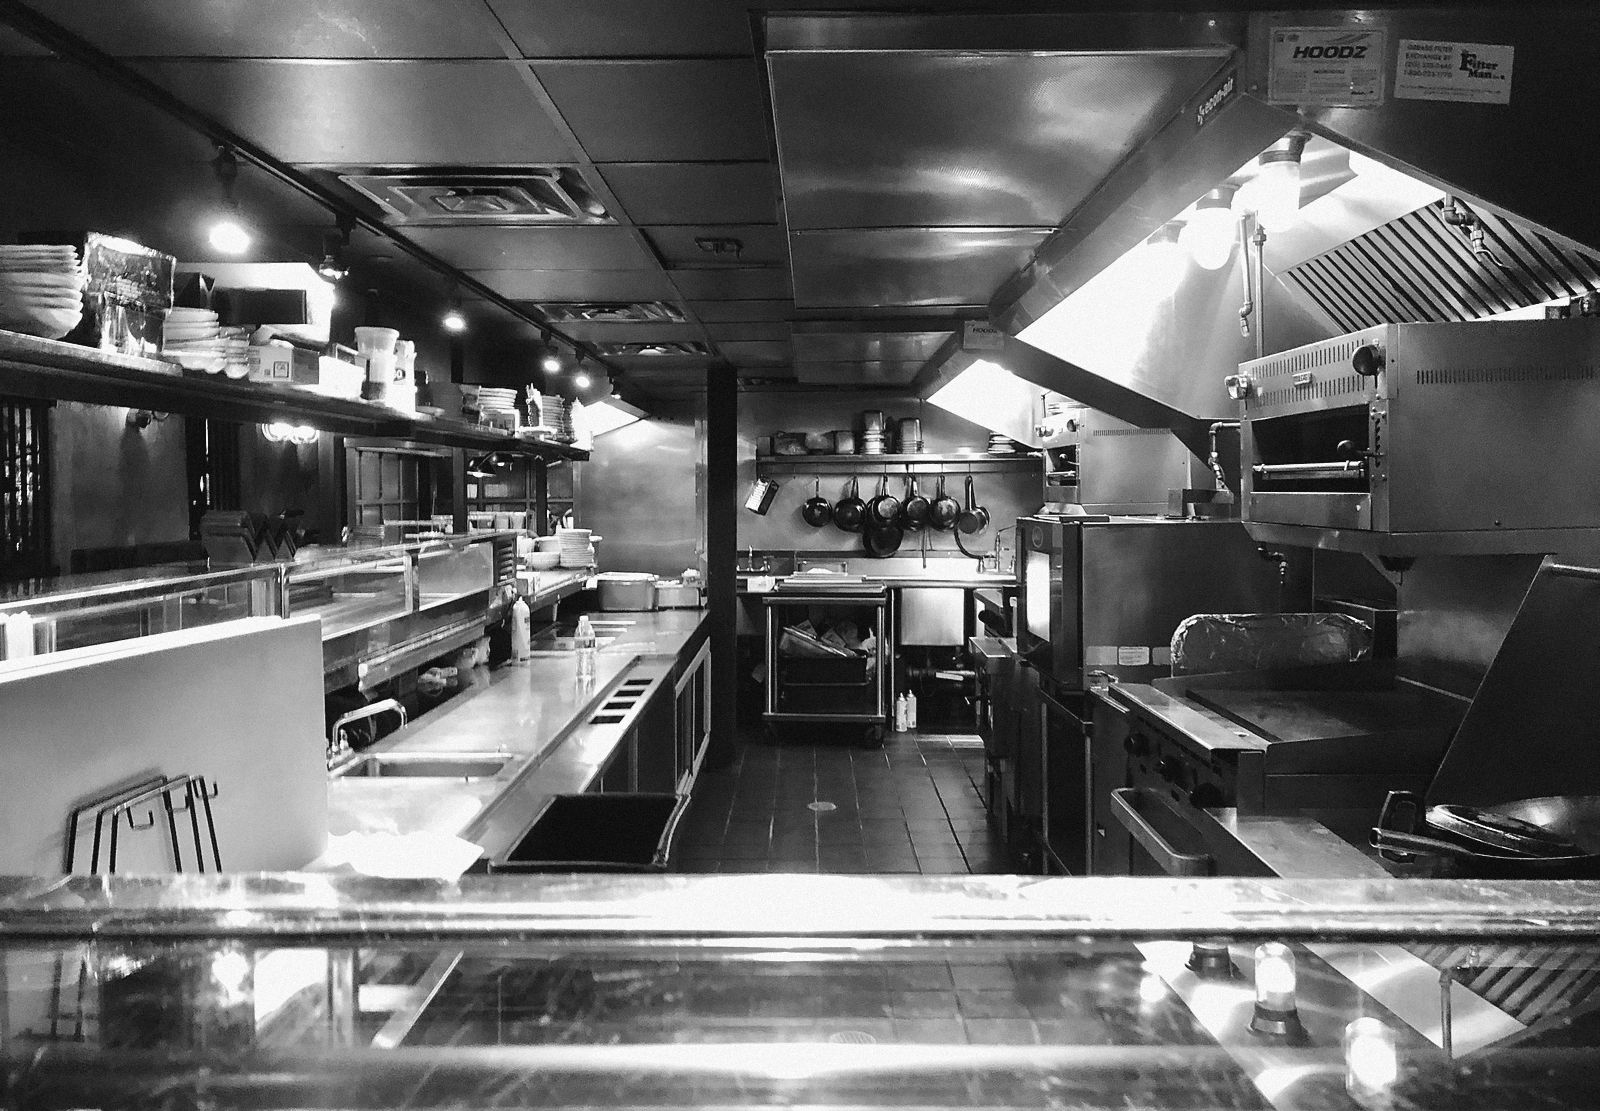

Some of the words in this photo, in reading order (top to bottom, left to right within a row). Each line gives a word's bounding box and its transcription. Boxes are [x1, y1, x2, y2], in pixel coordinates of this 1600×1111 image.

[1292, 46, 1368, 59] HOODZ
[1459, 53, 1499, 71] Filter
[1468, 69, 1492, 79] Man
